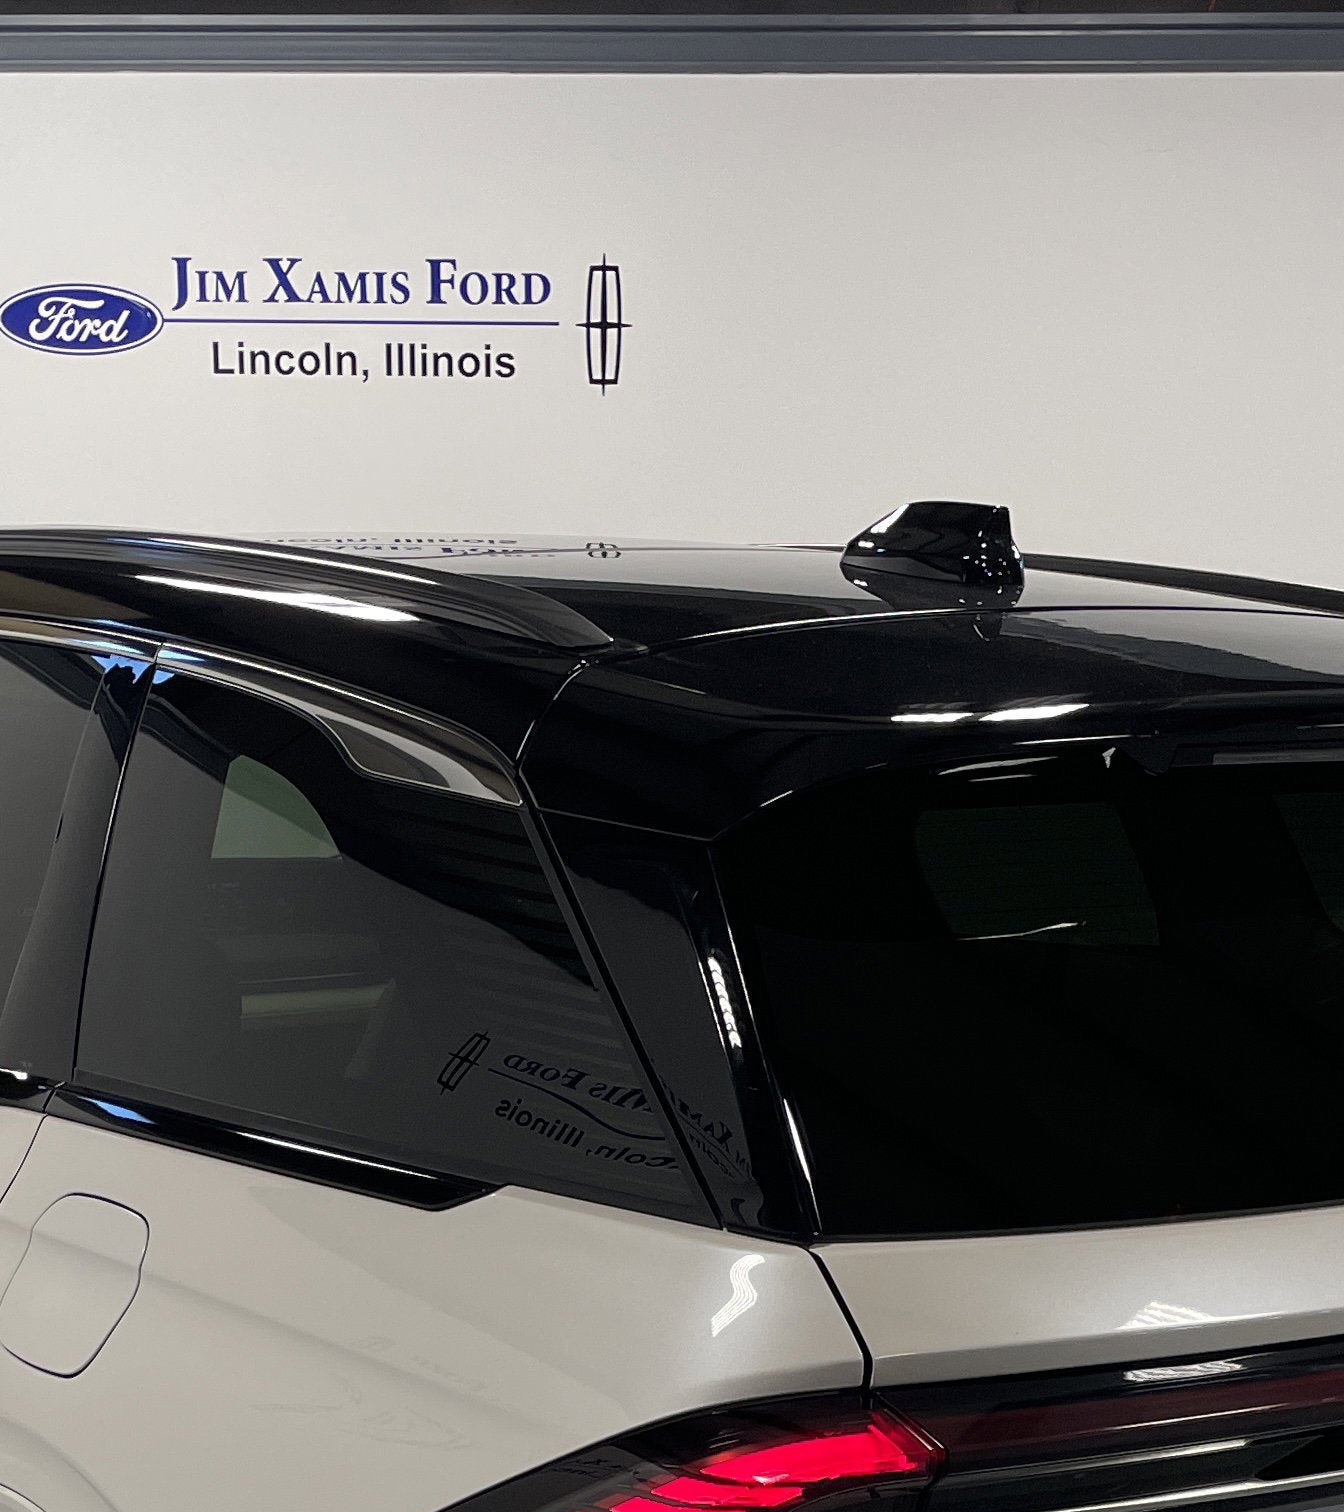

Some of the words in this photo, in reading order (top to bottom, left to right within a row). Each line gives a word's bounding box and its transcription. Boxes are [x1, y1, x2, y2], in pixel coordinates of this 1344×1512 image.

[171, 256, 248, 312] JIM
[262, 256, 410, 305] XAMIS
[425, 257, 552, 306] FORD
[29, 296, 130, 345] Ford
[211, 342, 370, 383] Lincoln,
[384, 342, 516, 379] Illinois
